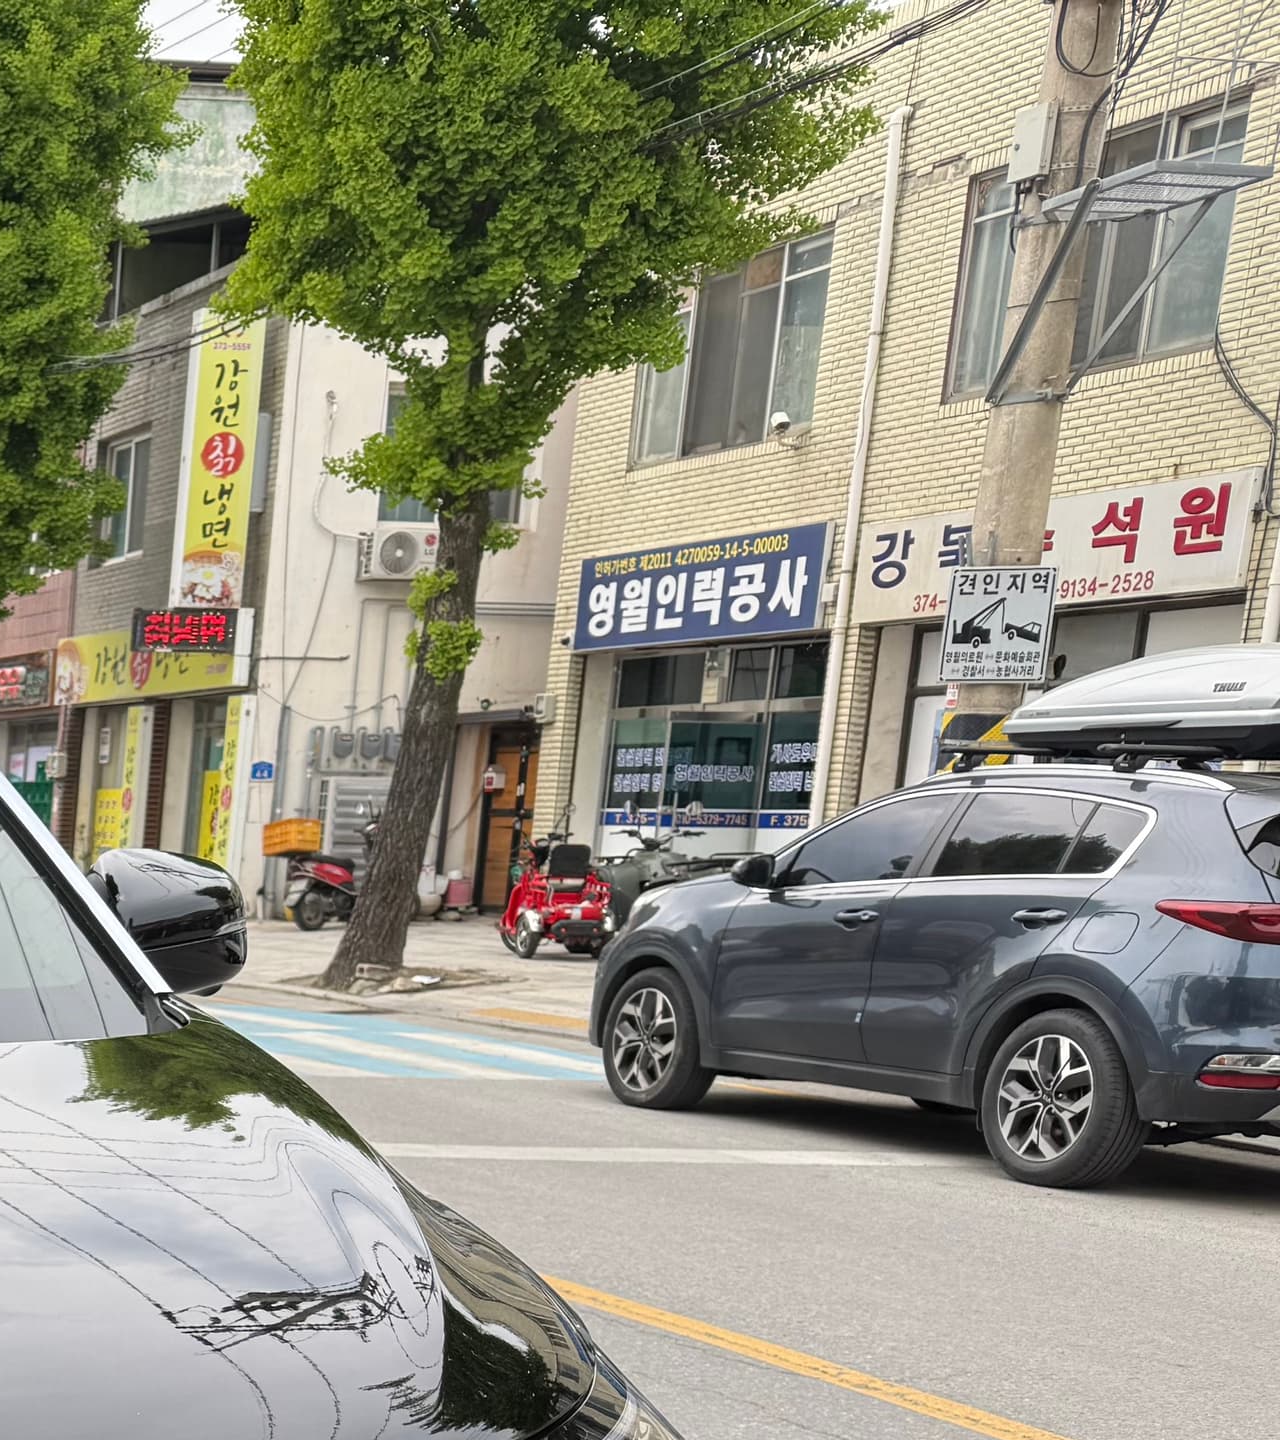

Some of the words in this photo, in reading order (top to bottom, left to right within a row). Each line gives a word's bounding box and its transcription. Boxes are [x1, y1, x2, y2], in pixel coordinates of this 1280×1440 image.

[675, 534, 789, 566] 4270059-14-5-00003
[958, 571, 1050, 596] 견인지역
[588, 556, 808, 637] 영월인력공사
[1212, 680, 1247, 693] THULE
[674, 765, 755, 782] 영월인력공사
